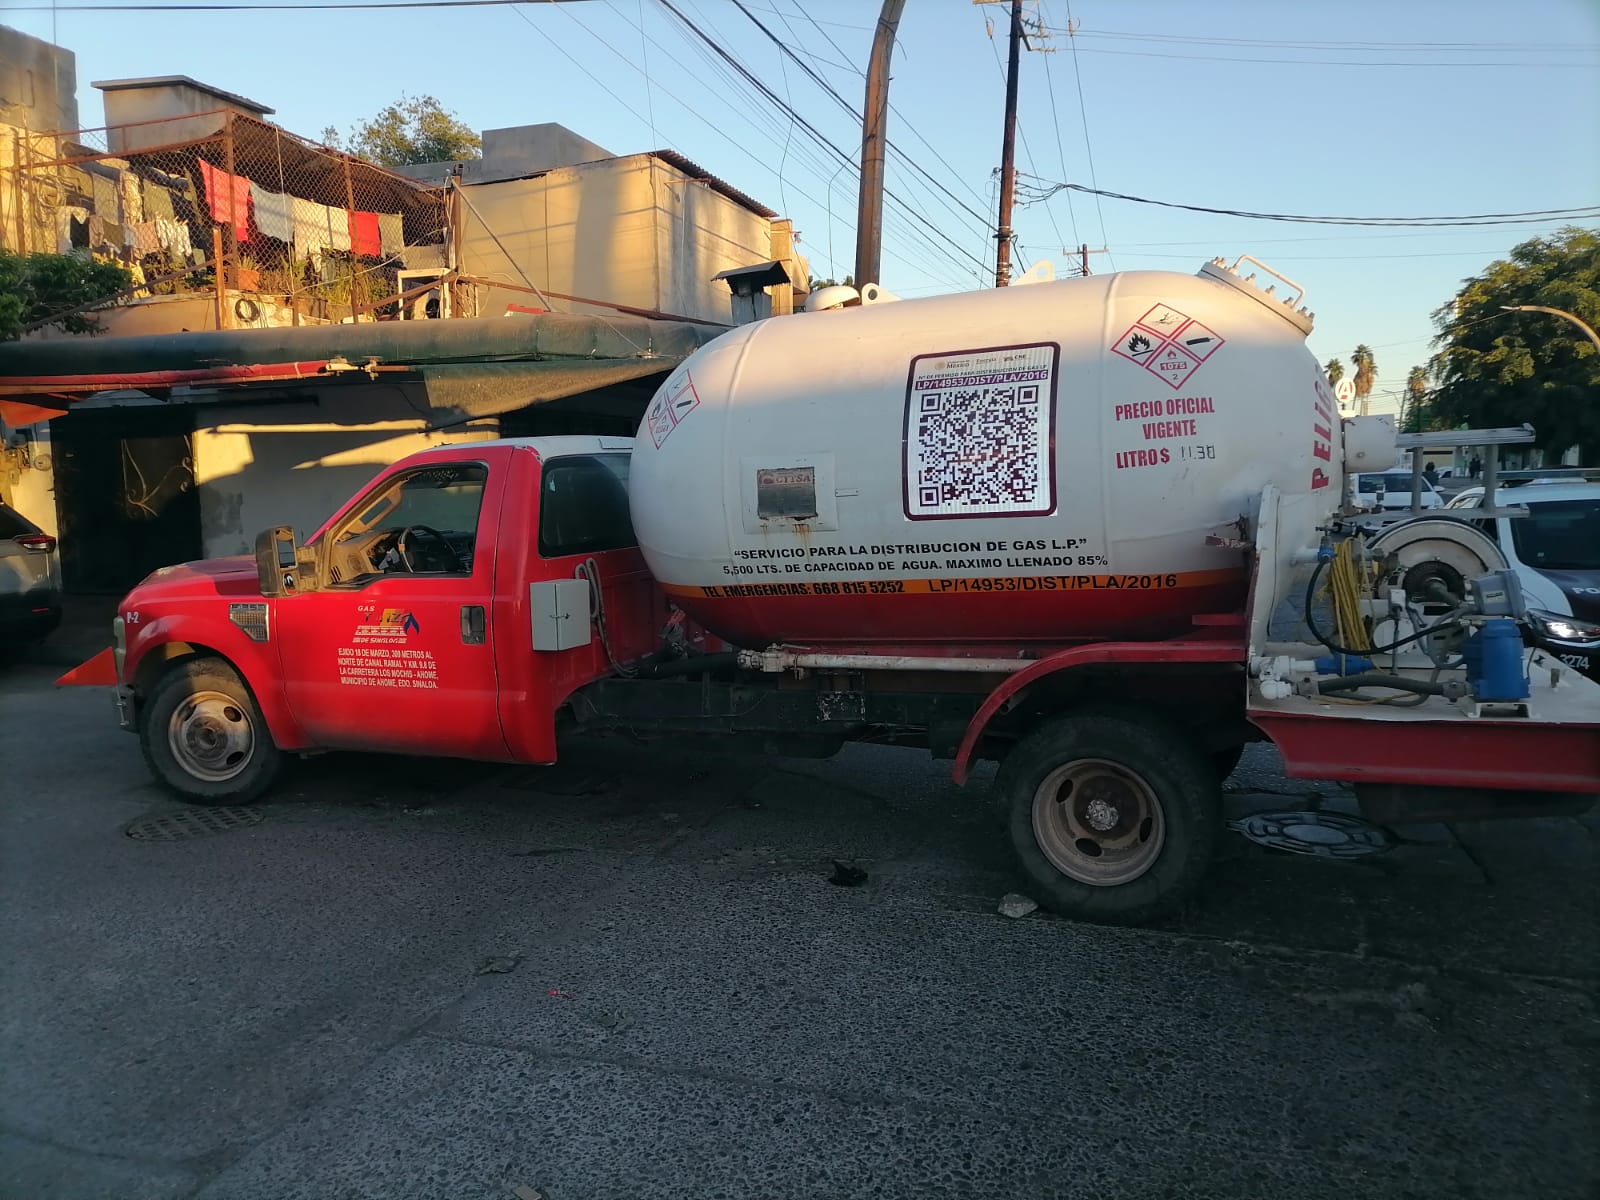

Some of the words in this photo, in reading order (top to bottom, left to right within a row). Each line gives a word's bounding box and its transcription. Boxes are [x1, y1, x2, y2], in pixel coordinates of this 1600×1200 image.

[1161, 362, 1186, 370] 1075
[917, 370, 1047, 389] LP/14953/DIST/PLA/2016
[1115, 400, 1163, 421] PRECIO
[1166, 397, 1215, 415] OFICIAL
[1143, 419, 1197, 440] VIGENTE
[810, 546, 846, 556] PARA
[850, 545, 868, 555] LA
[871, 541, 981, 555] DISTRIBUCION
[986, 541, 1007, 551] DE
[1012, 540, 1046, 550] GAS
[723, 565, 753, 576] 5,500
[756, 565, 782, 574] LTS.
[785, 564, 801, 573] DE
[804, 562, 874, 572] CAPACIDAD
[878, 561, 895, 570] DE
[902, 560, 942, 570] AGUA.
[946, 558, 1002, 569] MAXIMO
[1007, 556, 1073, 567] LLENADO
[1078, 555, 1108, 566] 85%
[724, 583, 812, 597] EMERGENCIAS:
[814, 582, 840, 595] 668
[843, 582, 867, 594] 815
[869, 581, 904, 593] 5252
[927, 574, 1177, 592] LP/14953/DIST/PLA/2016
[126, 612, 140, 624] P-2
[402, 650, 424, 658] METROS
[425, 651, 433, 659] AL
[356, 658, 364, 666] DE
[380, 669, 391, 677] LOS
[368, 678, 376, 686] DE
